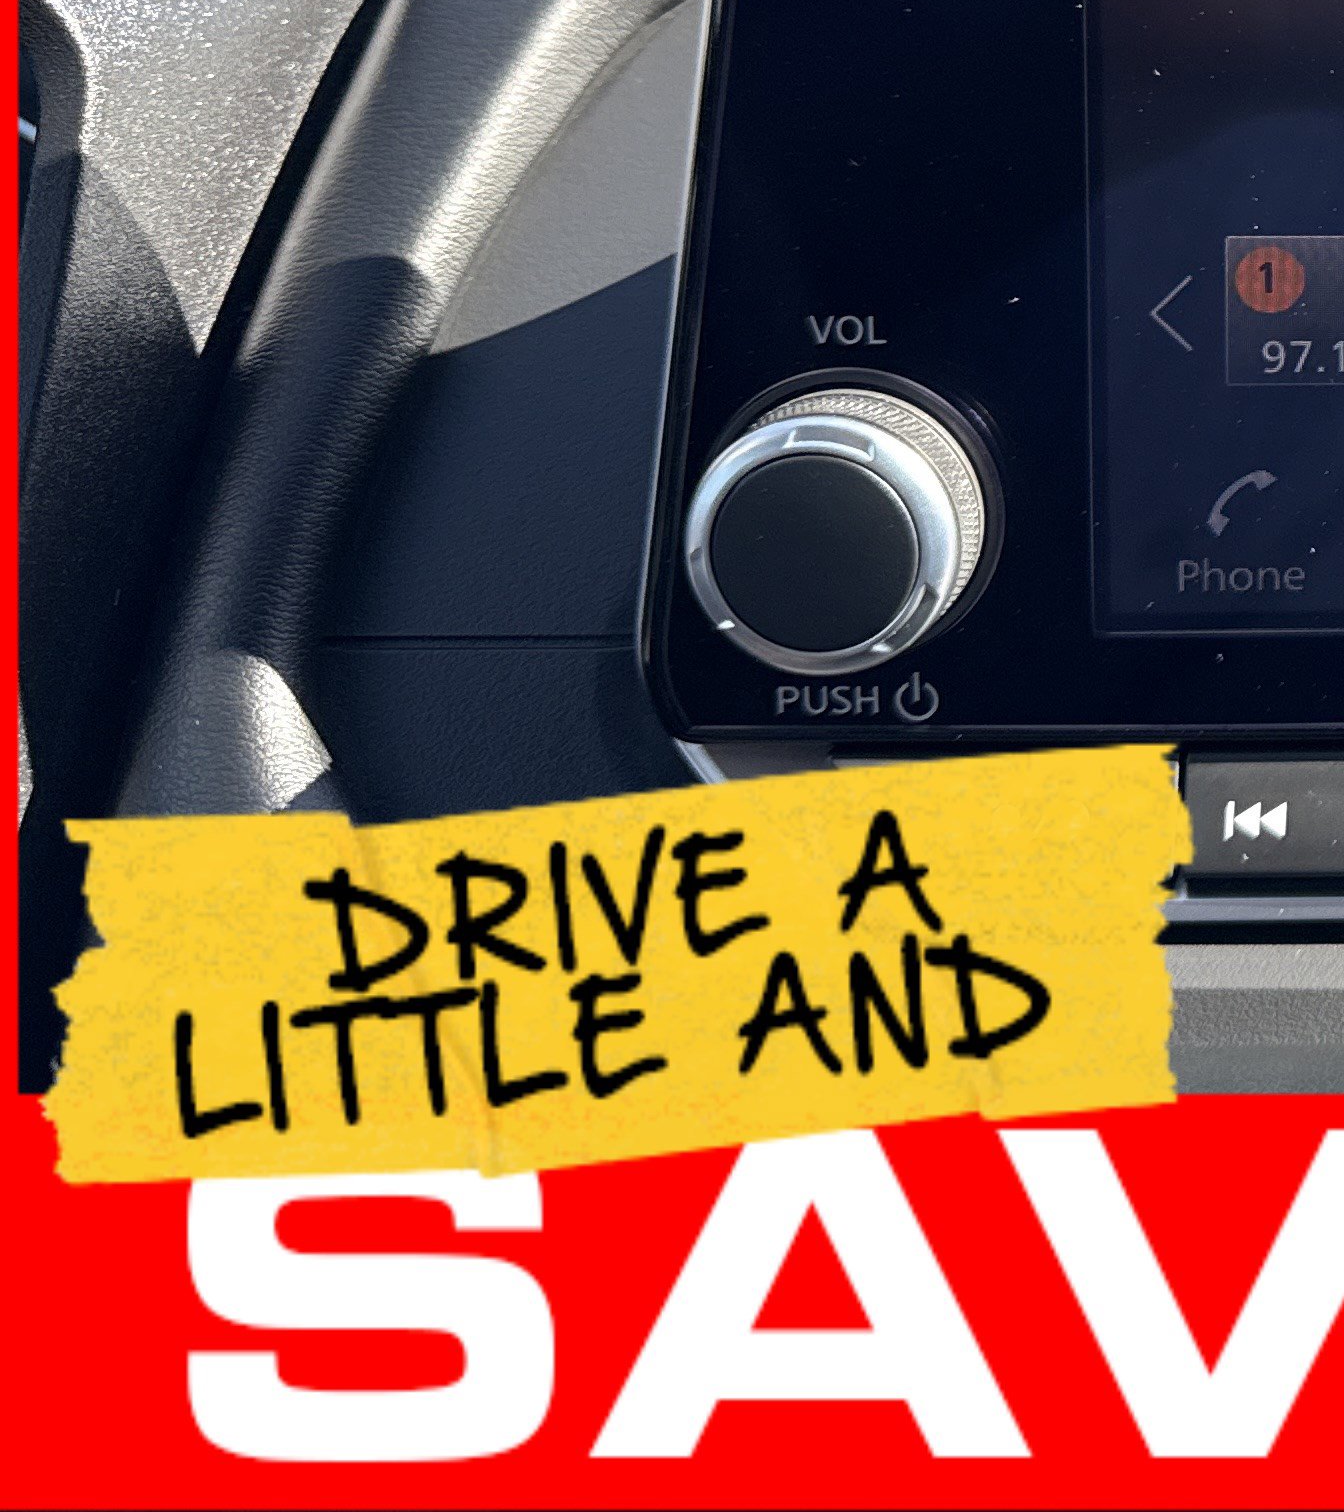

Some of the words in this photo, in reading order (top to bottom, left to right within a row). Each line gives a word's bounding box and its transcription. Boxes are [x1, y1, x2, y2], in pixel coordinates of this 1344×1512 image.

[1257, 262, 1274, 294] 1
[808, 315, 888, 345] VOL
[1176, 559, 1307, 594] Phone
[775, 685, 880, 715] PUSH
